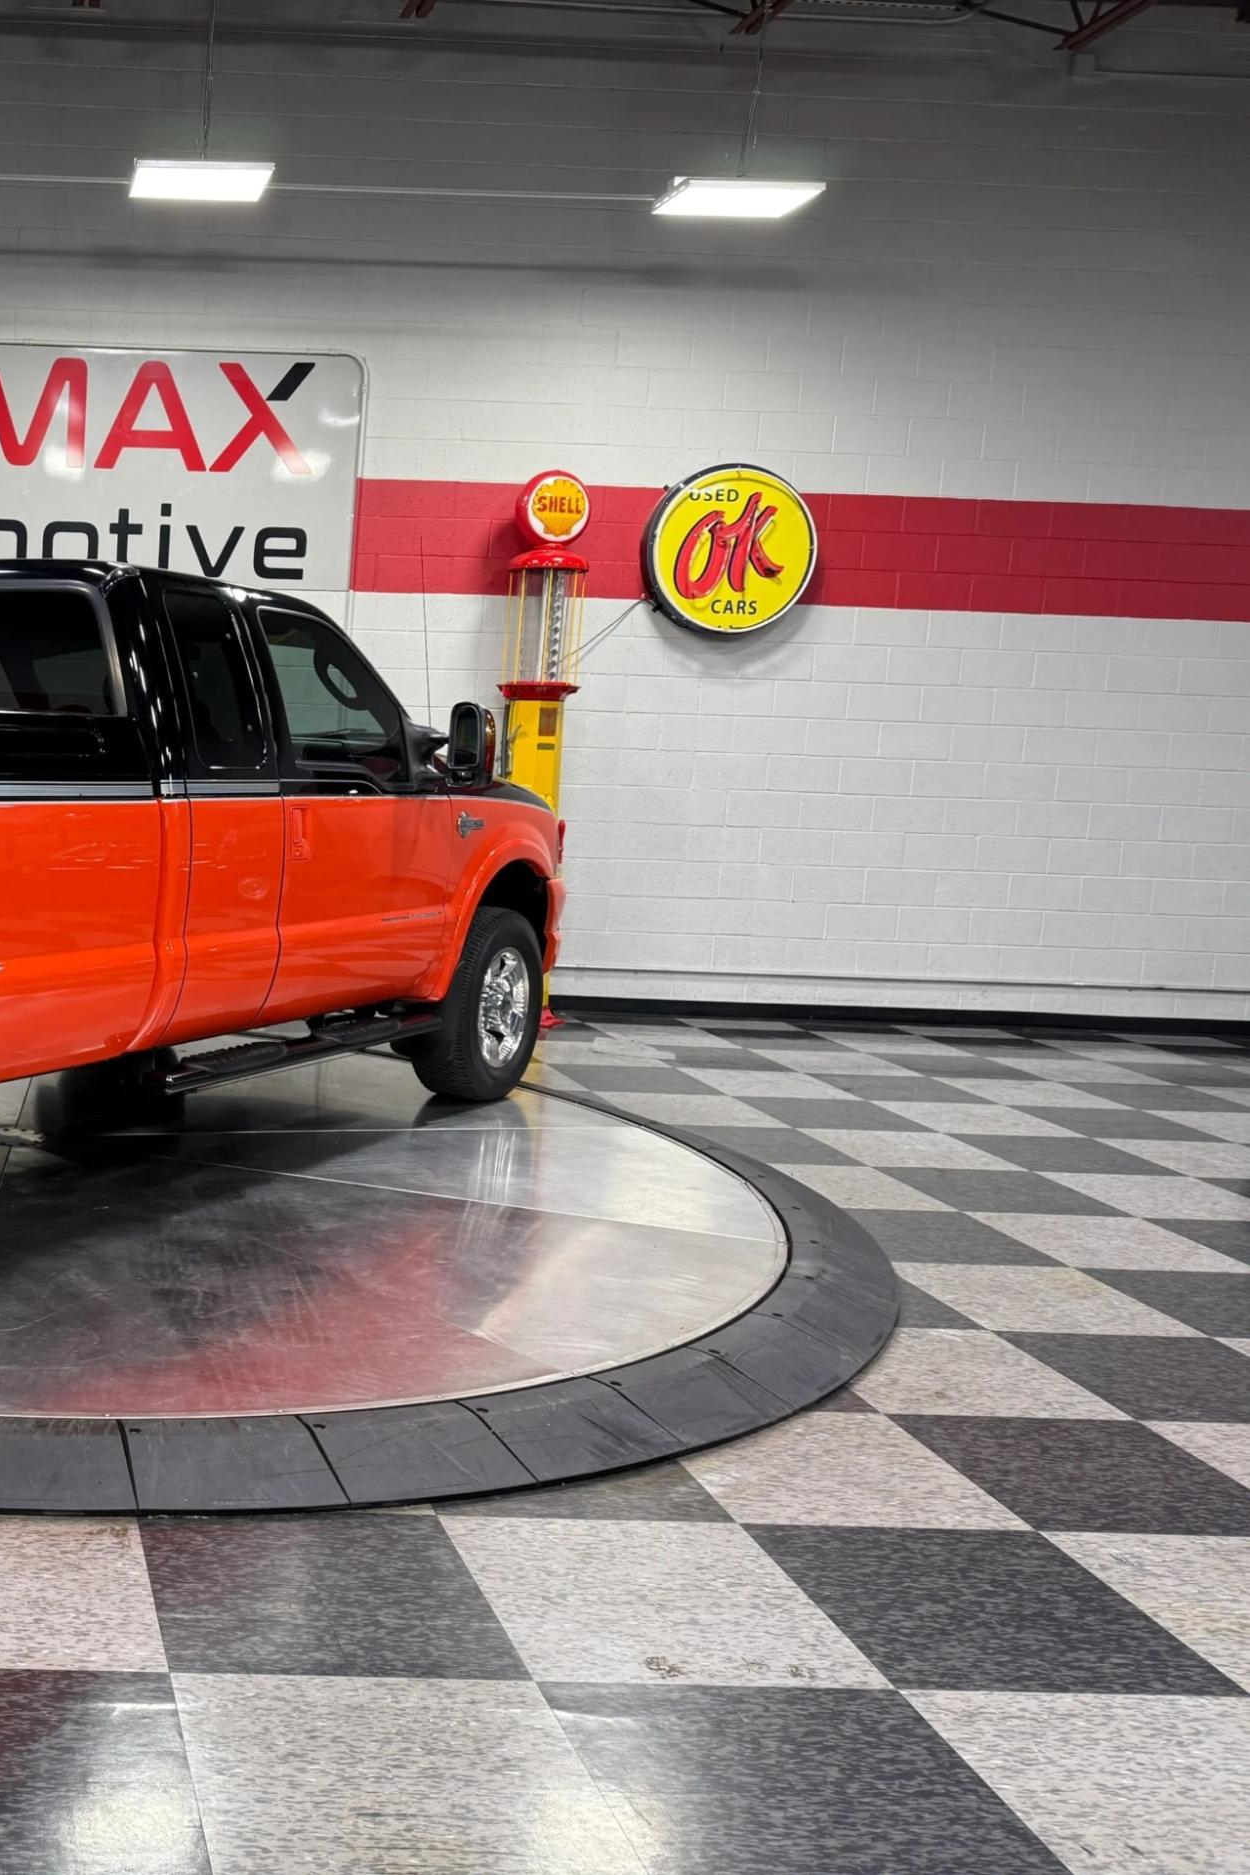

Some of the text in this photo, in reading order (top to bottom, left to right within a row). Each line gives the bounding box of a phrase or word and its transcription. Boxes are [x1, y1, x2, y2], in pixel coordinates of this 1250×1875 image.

[689, 488, 739, 503] USED
[537, 496, 582, 514] SHELL
[711, 600, 757, 615] CARS
